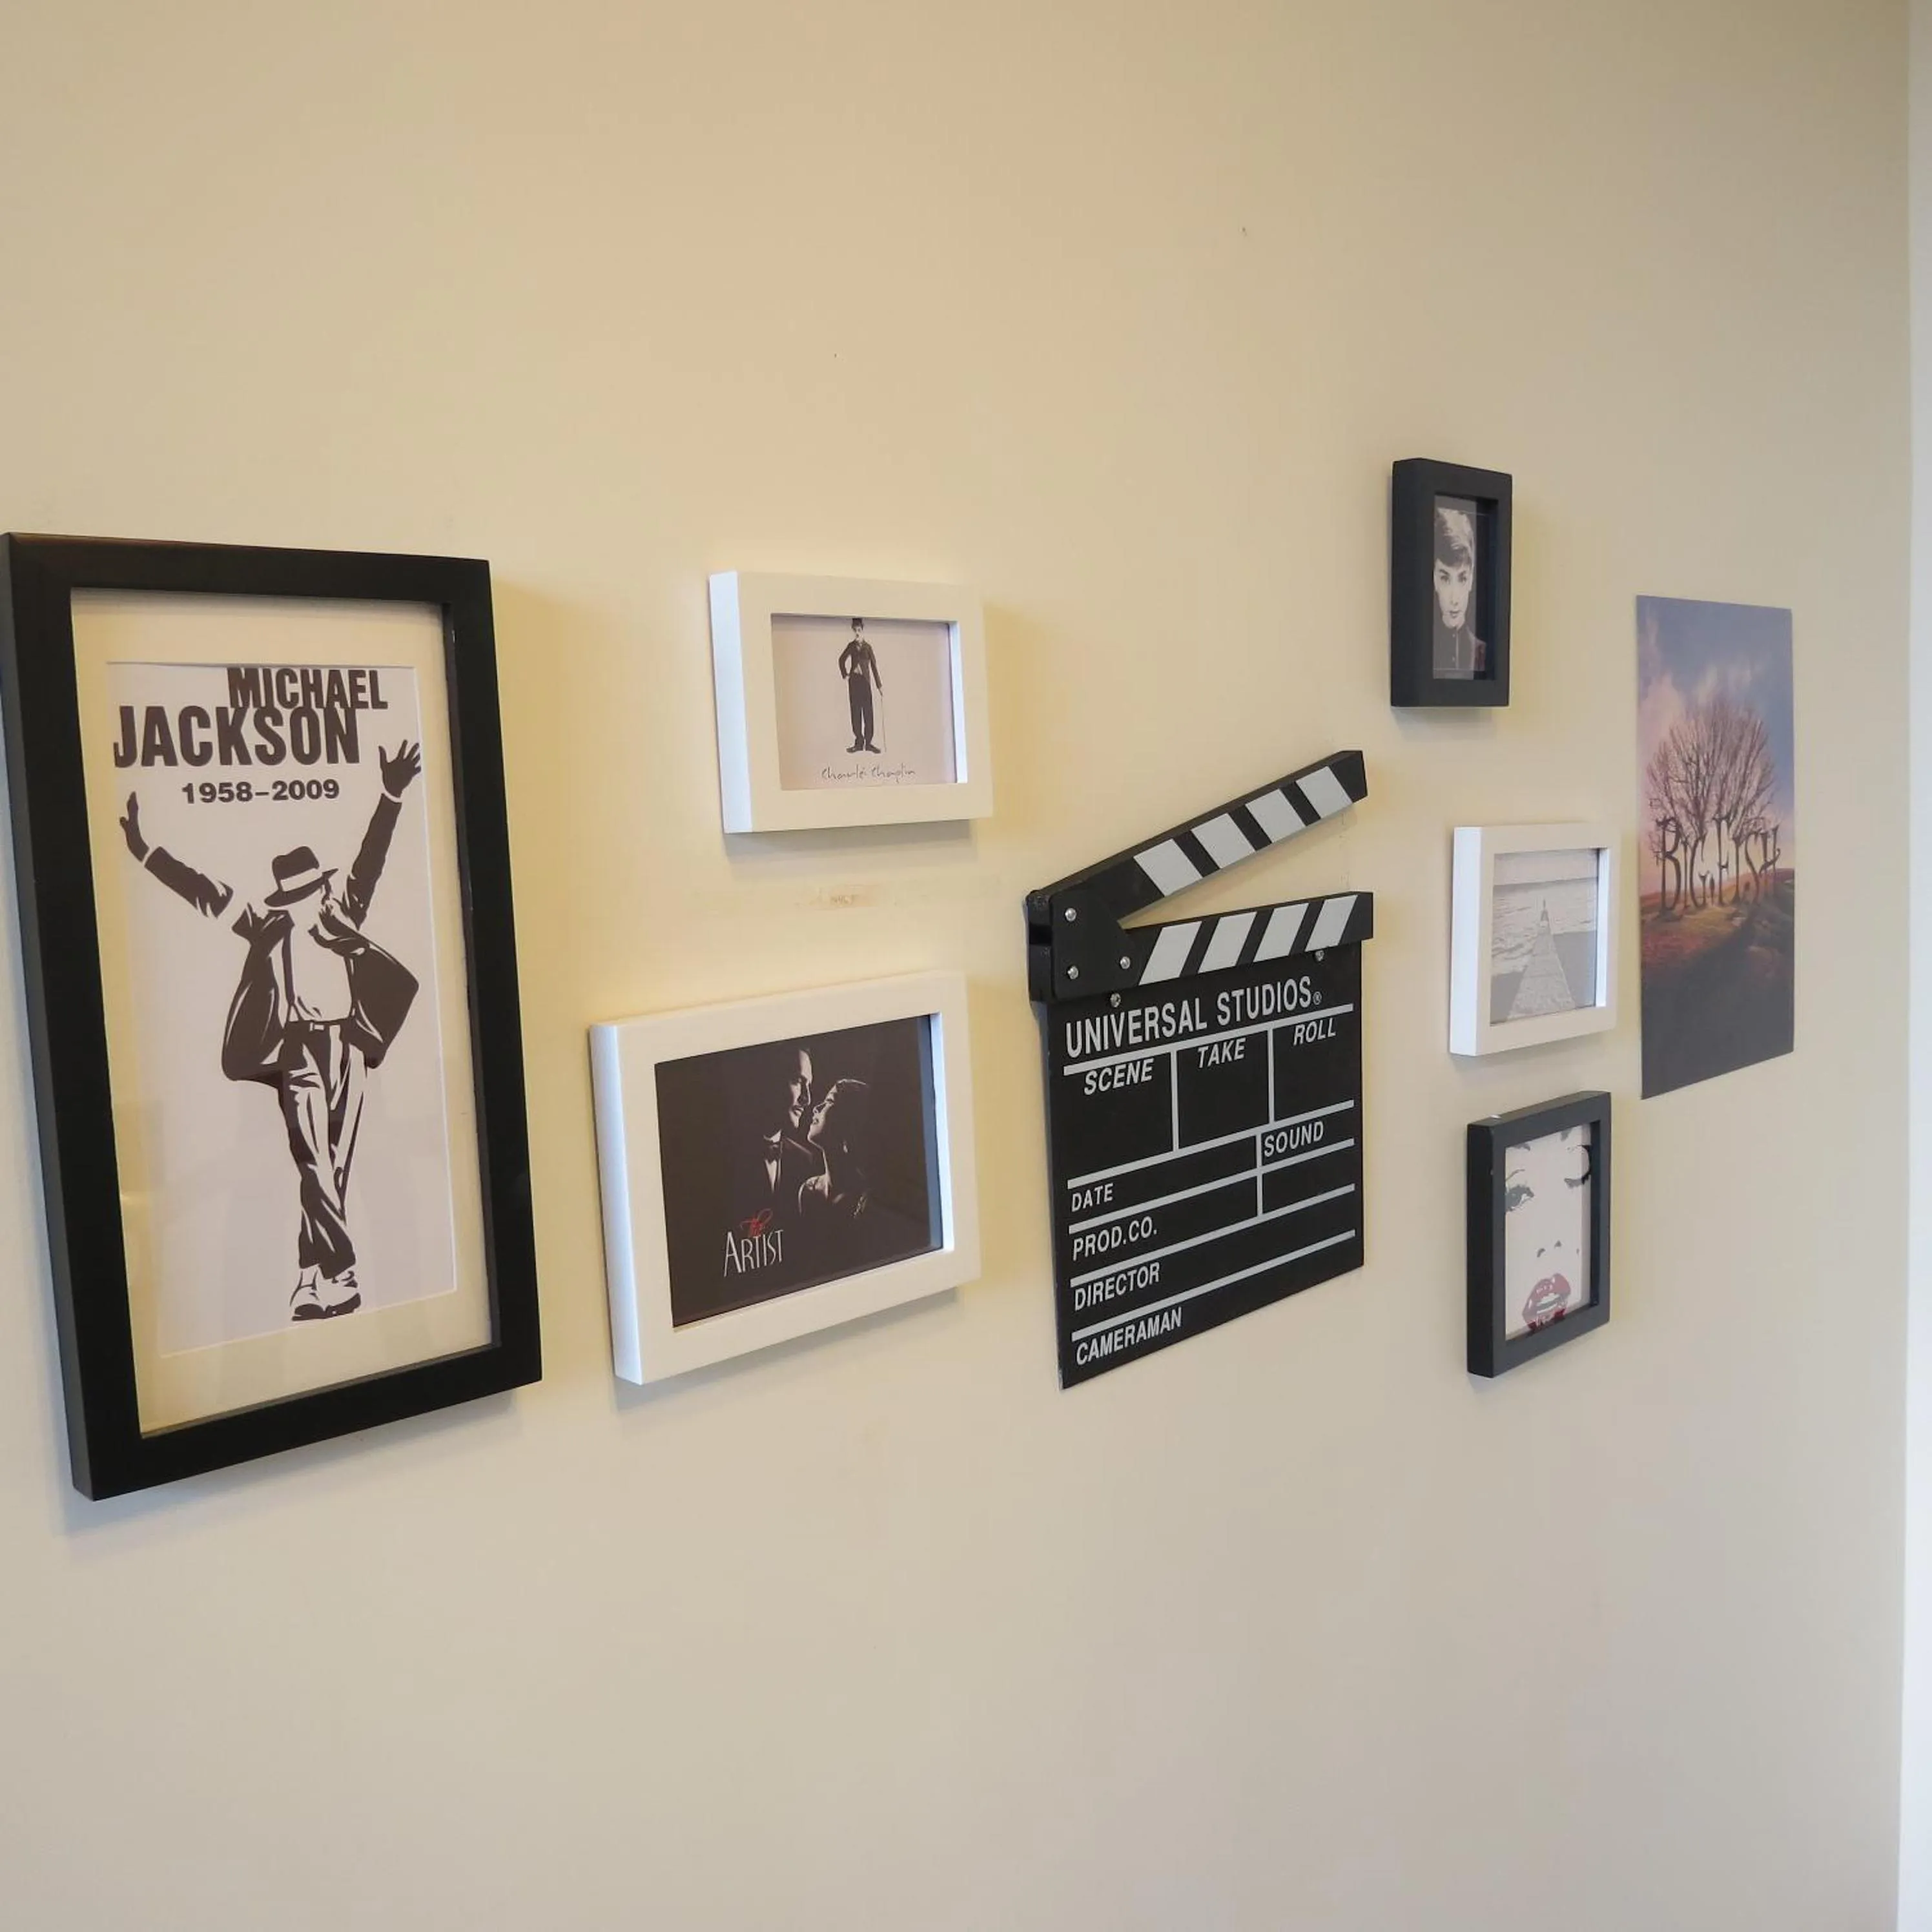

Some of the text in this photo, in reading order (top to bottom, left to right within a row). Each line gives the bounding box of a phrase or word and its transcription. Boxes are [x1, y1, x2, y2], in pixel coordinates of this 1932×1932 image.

[227, 667, 387, 709] MICHAEL
[114, 705, 360, 768] JACKSON
[1066, 998, 1208, 1058] UNIVERSAL
[1293, 1017, 1337, 1047] ROLL
[1197, 1038, 1246, 1069] TAKE
[1084, 1058, 1155, 1096] SCENE
[1264, 1121, 1324, 1158] SOUND
[1071, 1182, 1114, 1213] DATE
[724, 1229, 784, 1277] ARTIST
[1073, 1215, 1158, 1261] PROD.CO.
[1074, 1262, 1160, 1311] DIRECTOR
[1076, 1306, 1182, 1366] CAMERAMAN
